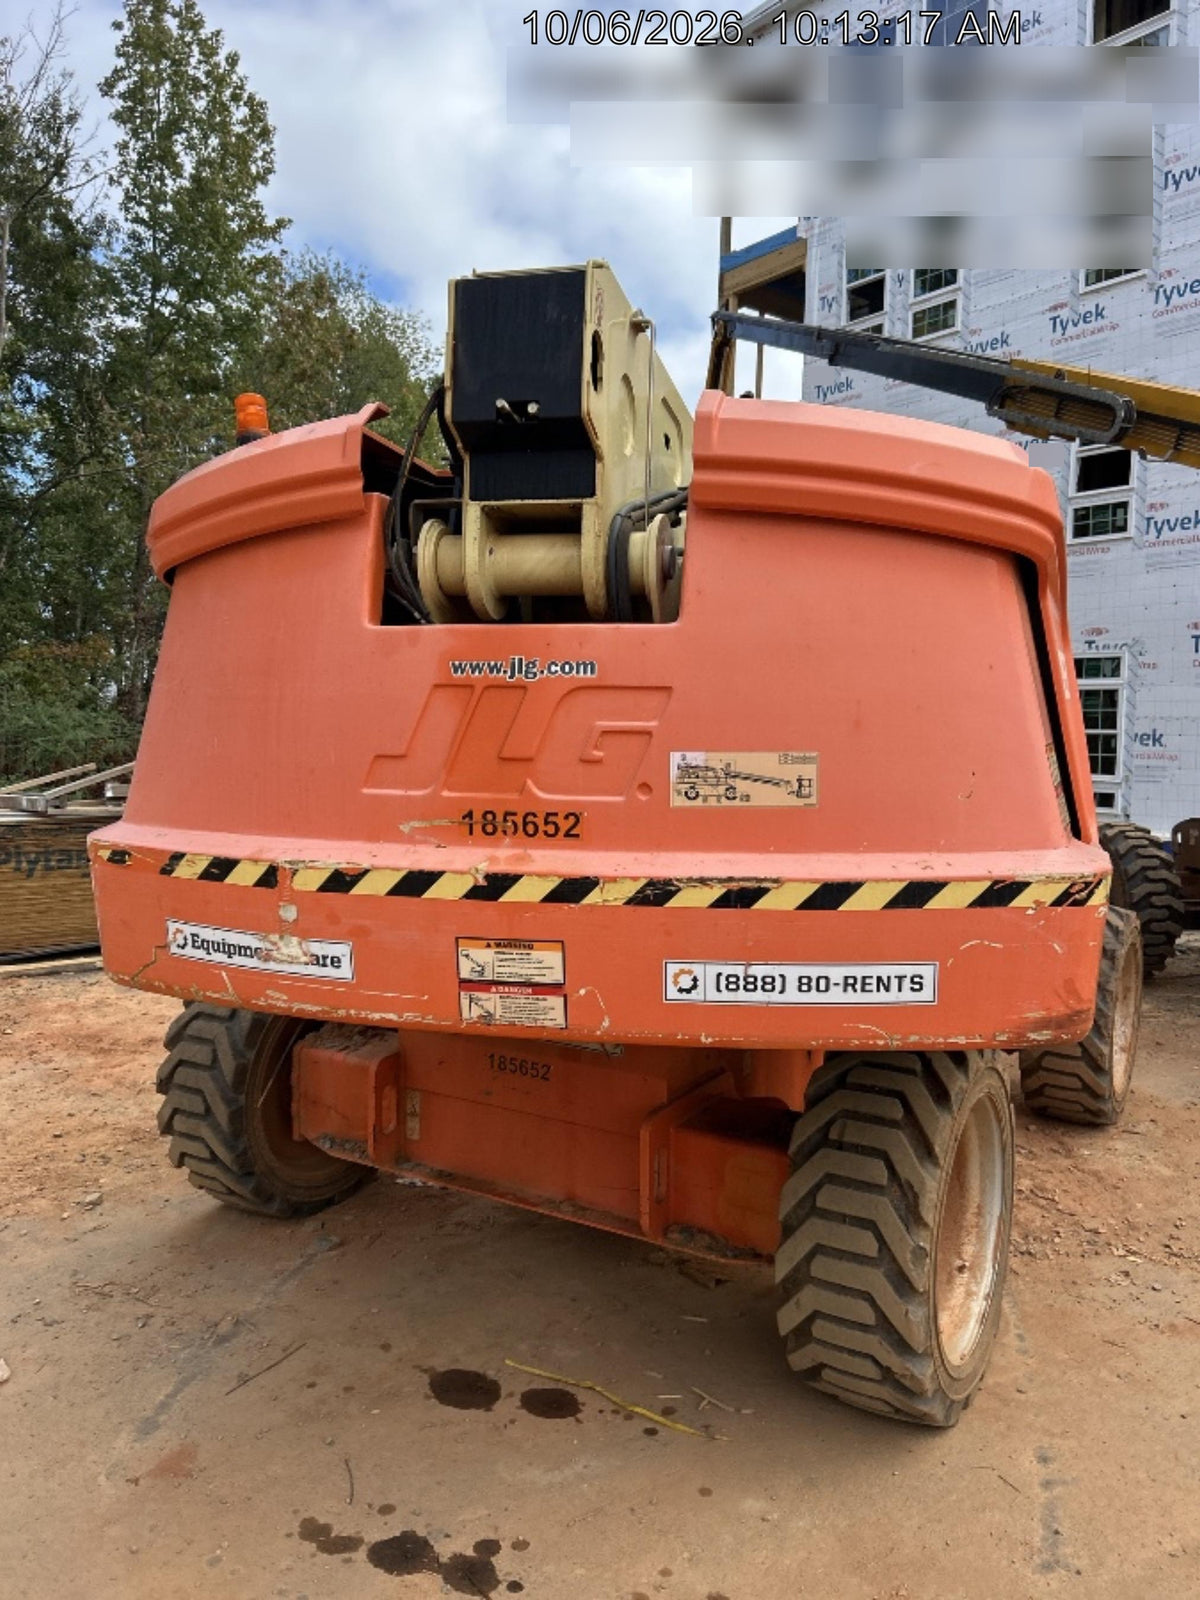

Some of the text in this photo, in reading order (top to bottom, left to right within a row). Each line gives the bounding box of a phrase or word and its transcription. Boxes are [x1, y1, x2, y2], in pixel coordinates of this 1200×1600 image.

[1163, 165, 1200, 192] Tyv
[1049, 303, 1106, 336] Tyvek
[963, 330, 1010, 353] yvek
[814, 376, 855, 401] Tyvek
[450, 656, 597, 681] www.jlg.com
[360, 683, 673, 801] JLG
[461, 809, 581, 838] 185652
[715, 972, 924, 994] (888) 80-RENTS
[488, 1053, 552, 1081] 185652
